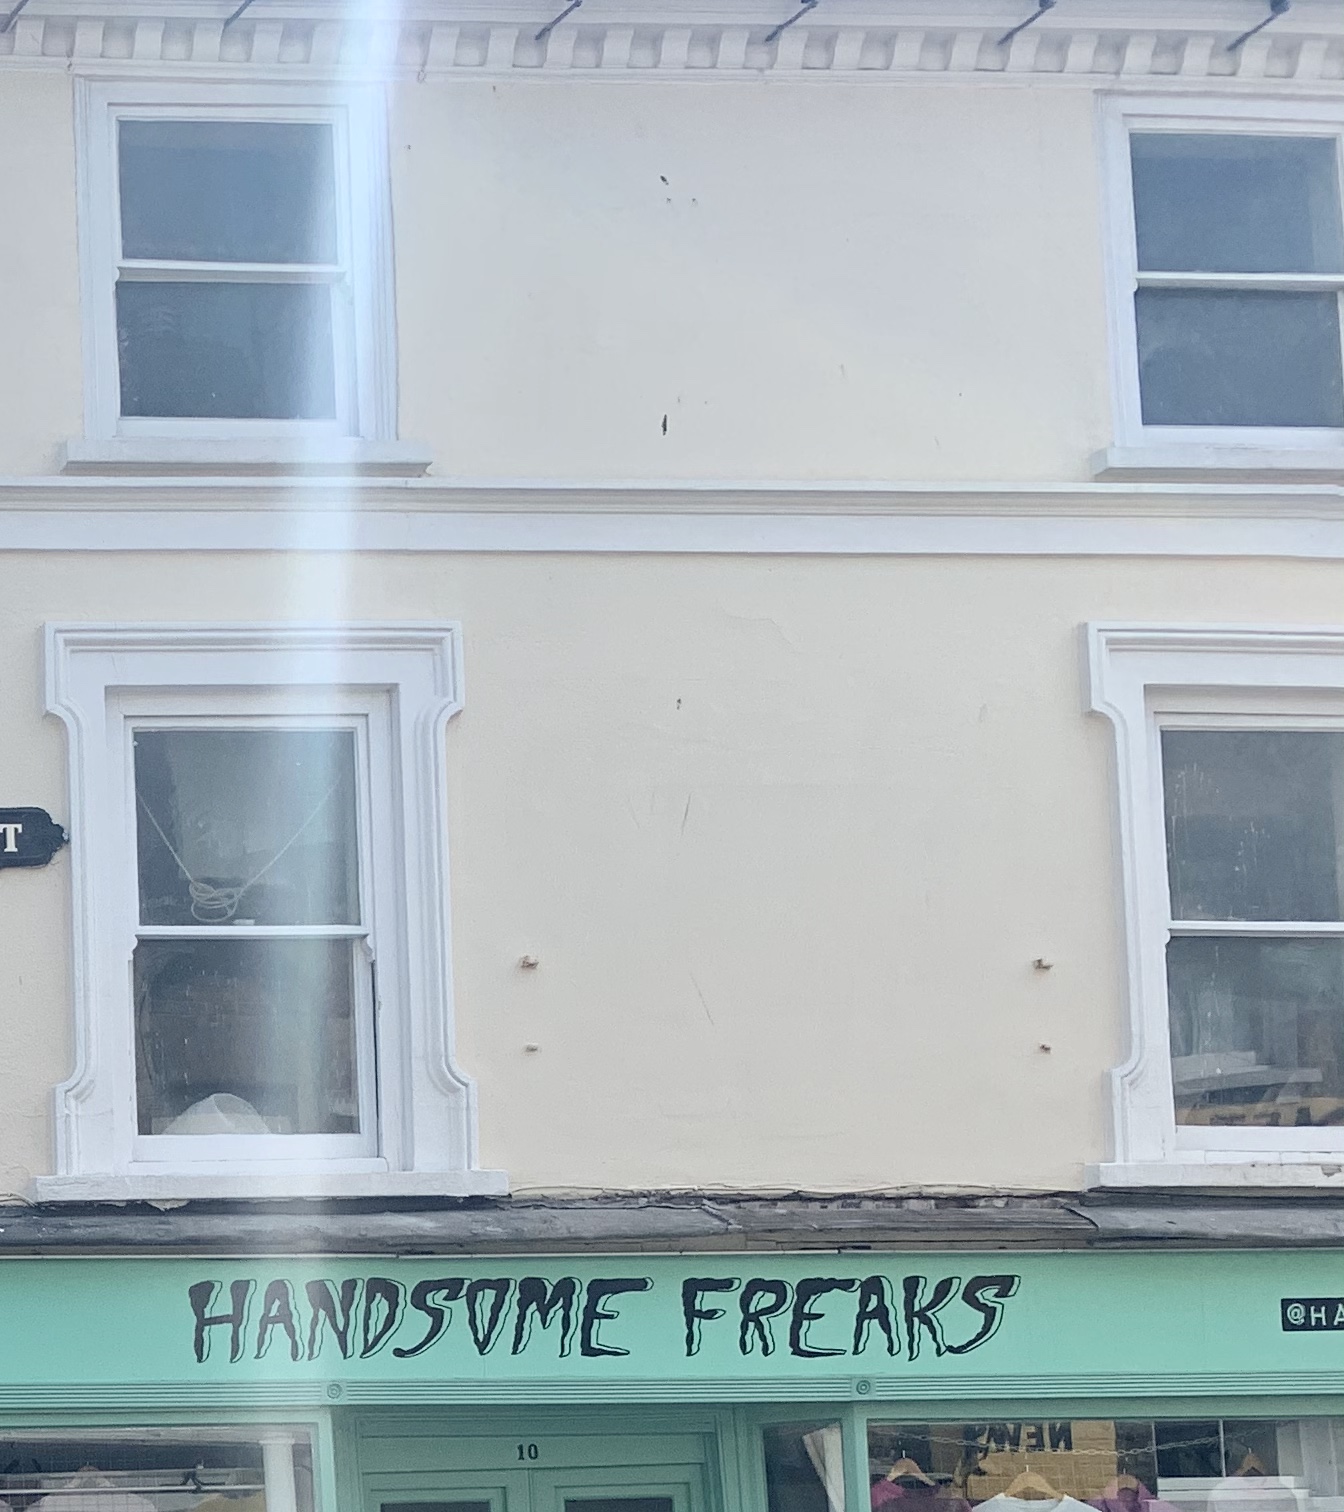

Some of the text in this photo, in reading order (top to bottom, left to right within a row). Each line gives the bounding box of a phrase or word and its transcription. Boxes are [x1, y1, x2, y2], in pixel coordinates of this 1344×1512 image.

[188, 1274, 1021, 1363] HANDSOME FREAKS
[517, 1443, 538, 1461] 10
